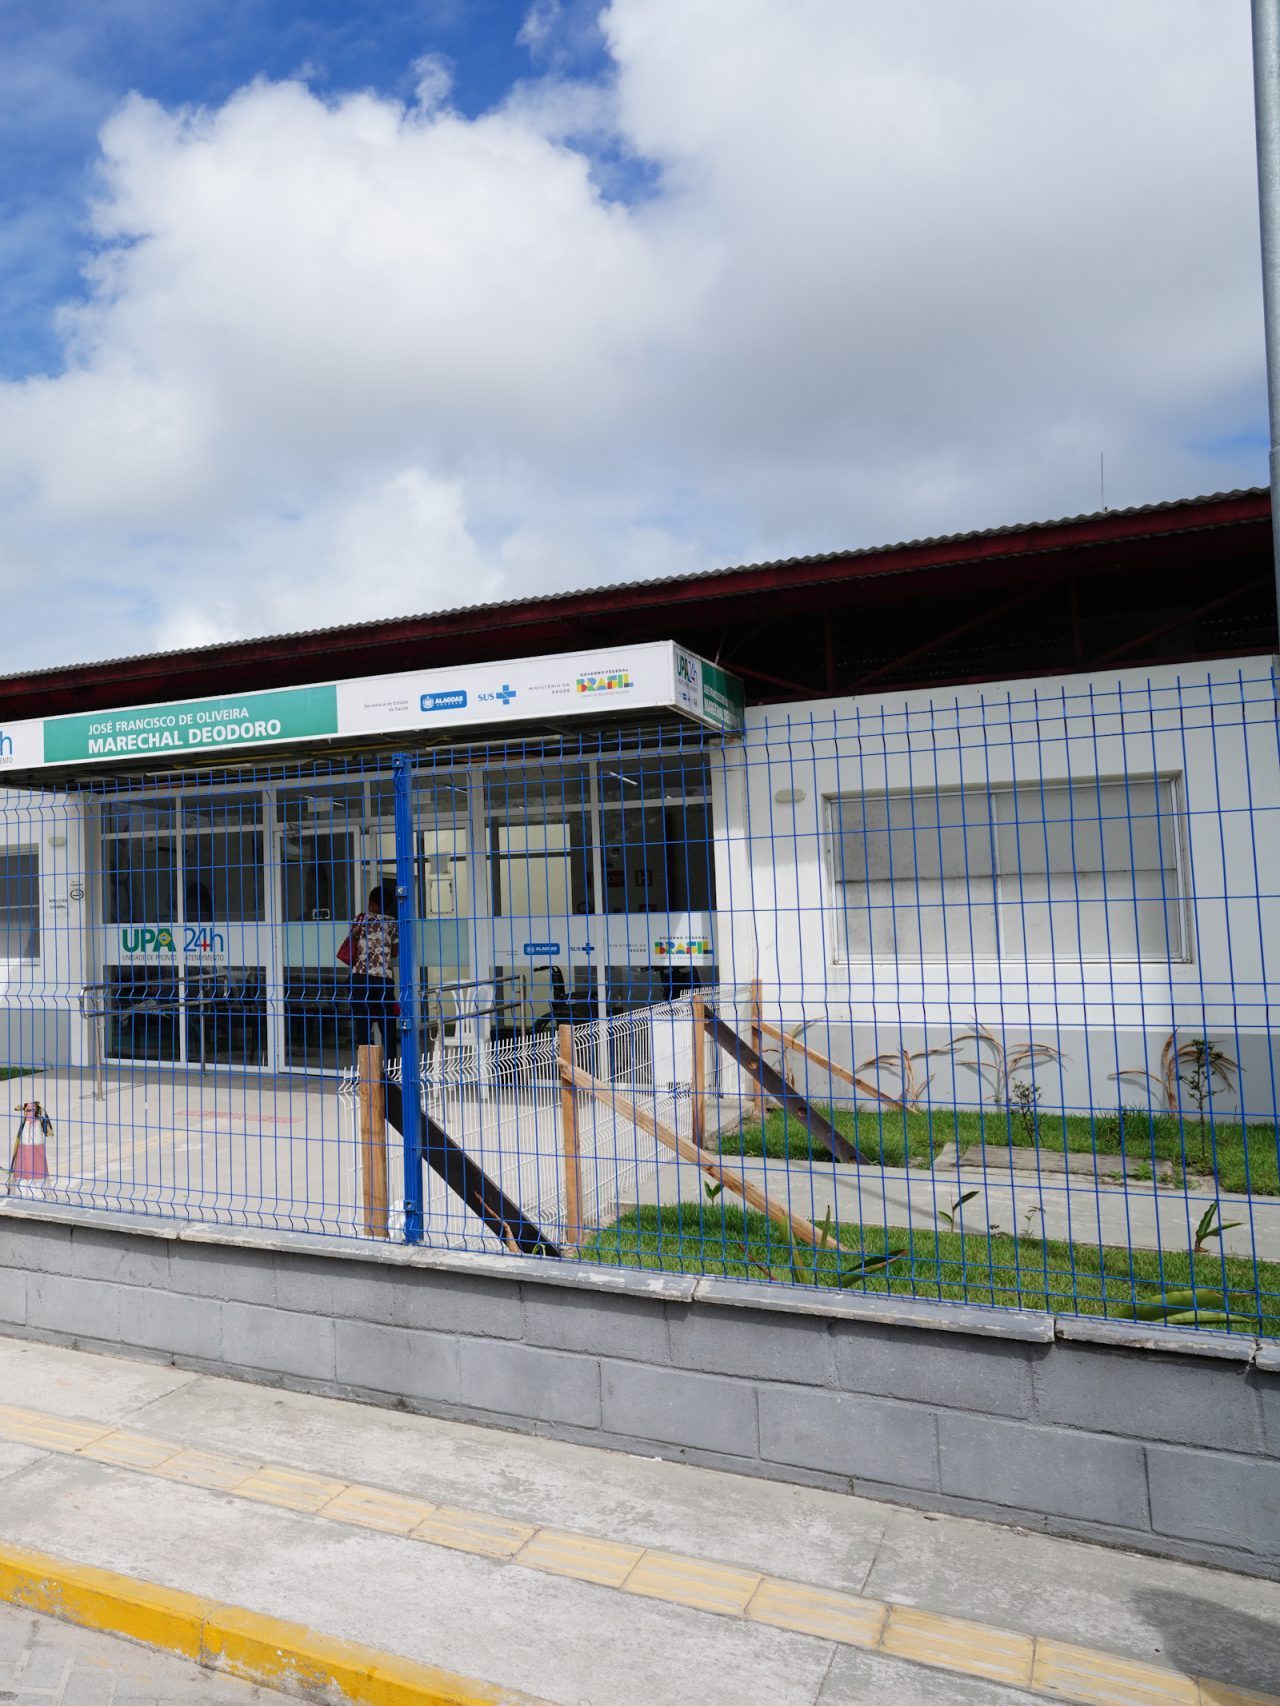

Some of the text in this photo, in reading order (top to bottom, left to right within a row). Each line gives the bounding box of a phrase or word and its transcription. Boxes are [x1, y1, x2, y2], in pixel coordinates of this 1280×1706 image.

[576, 673, 634, 692] BRASIL
[435, 695, 464, 705] ALAGOAS
[477, 693, 495, 702] SUS
[88, 707, 249, 735] JOSÉ FRANCISCO DE OLIVEIRA
[88, 719, 282, 754] MARECHAL DEODORO
[655, 941, 713, 954] BRASIL
